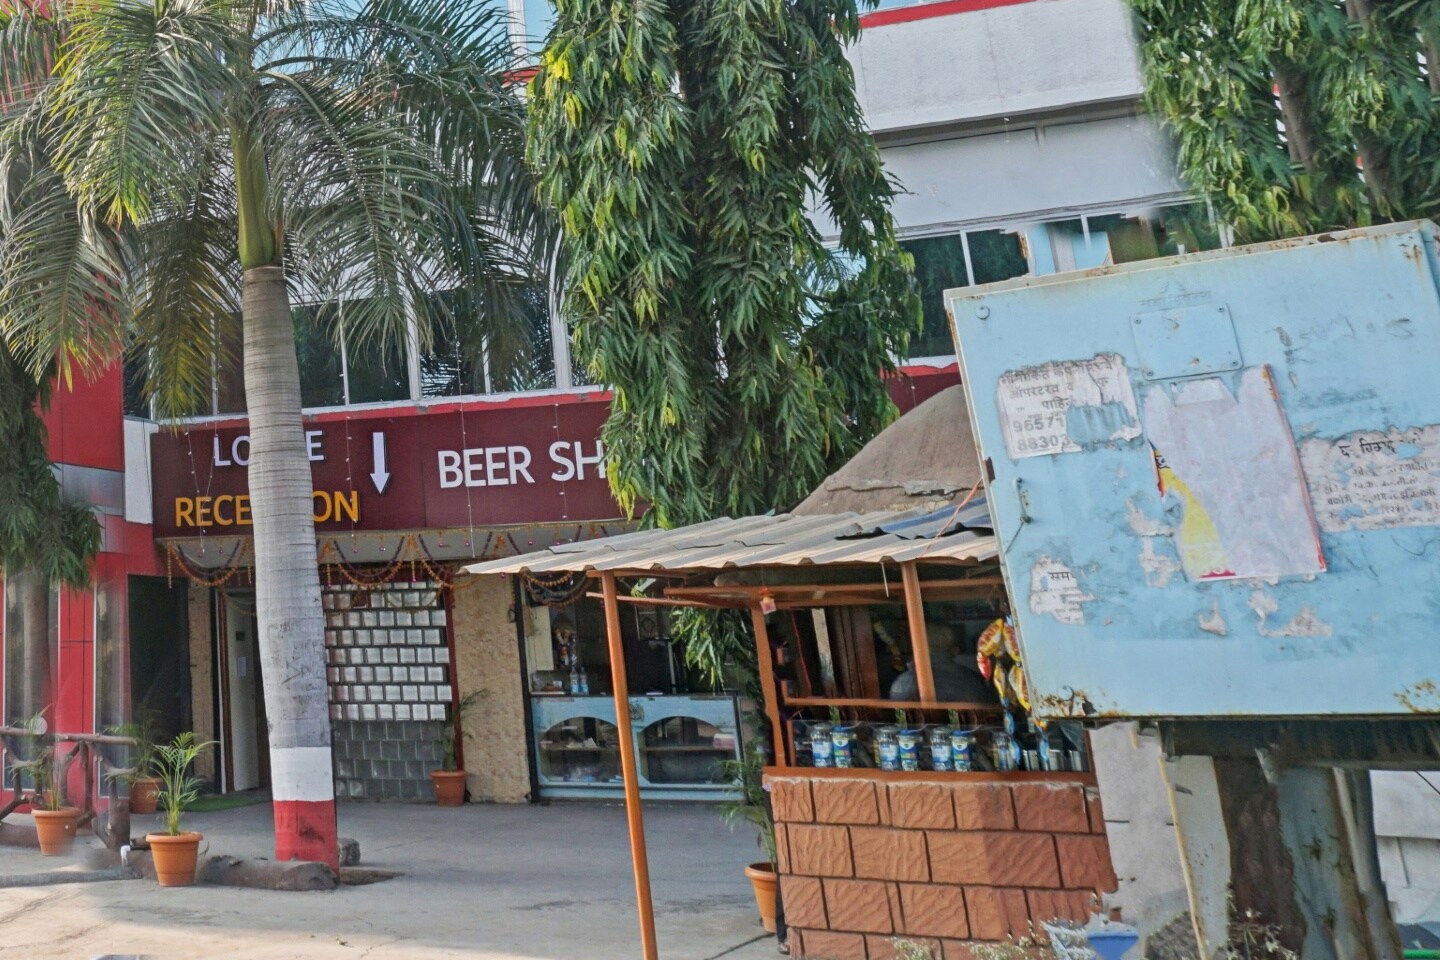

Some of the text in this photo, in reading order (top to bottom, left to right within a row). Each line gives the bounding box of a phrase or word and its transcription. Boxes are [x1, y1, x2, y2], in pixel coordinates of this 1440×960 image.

[214, 430, 326, 467] LOE
[437, 440, 608, 489] BEER SH
[175, 490, 359, 528] RECEON
